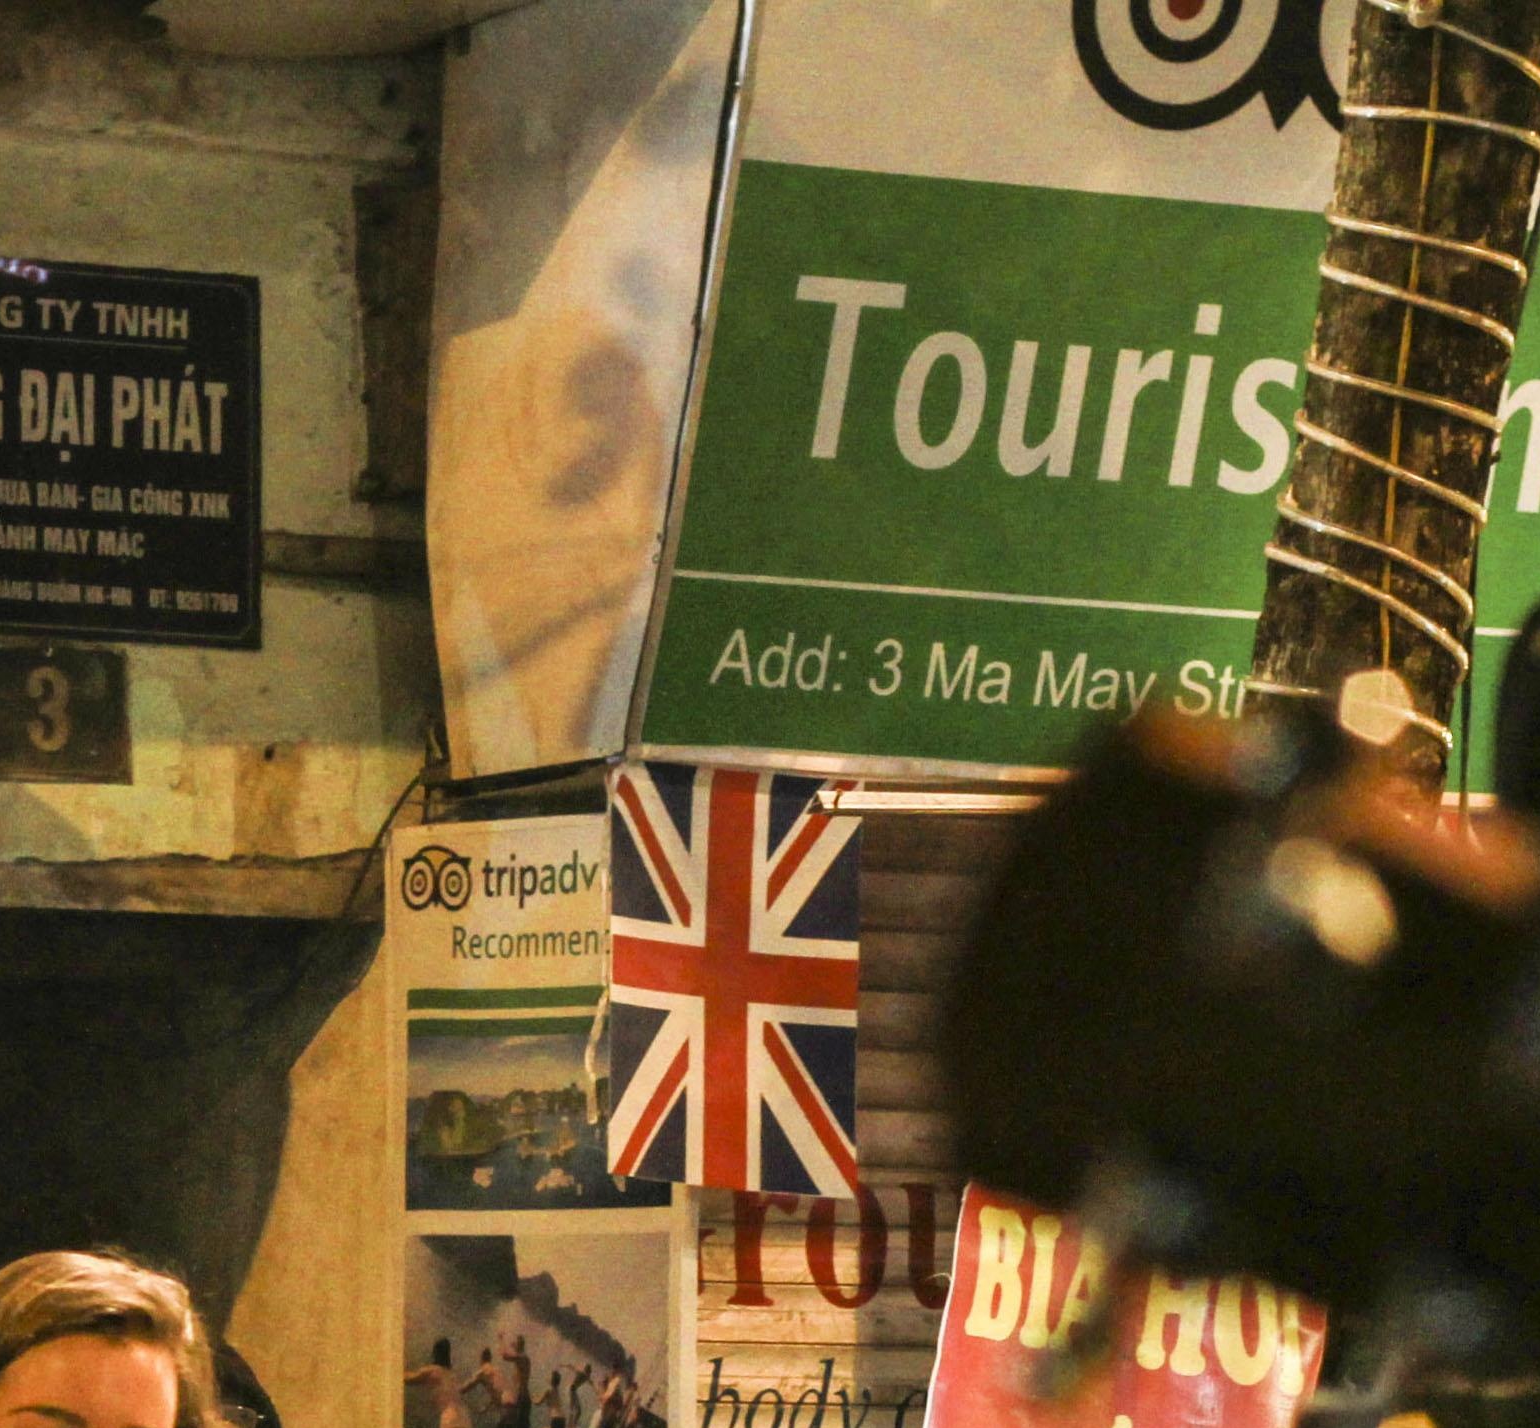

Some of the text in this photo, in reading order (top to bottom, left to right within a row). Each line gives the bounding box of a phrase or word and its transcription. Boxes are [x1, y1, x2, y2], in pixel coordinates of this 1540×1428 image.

[35, 298, 83, 332] TY
[92, 302, 190, 340] TNHH
[19, 367, 96, 463] ĐẠI
[111, 363, 229, 455] PHÁT
[795, 274, 1299, 496] Touris
[43, 527, 91, 555] MAY
[26, 665, 70, 752] 3
[709, 628, 848, 695] Add:
[868, 638, 904, 696] 3
[923, 642, 1010, 704] Ma
[1032, 650, 1158, 720] May
[482, 849, 599, 909] tripadv
[964, 1206, 1108, 1350] BIA
